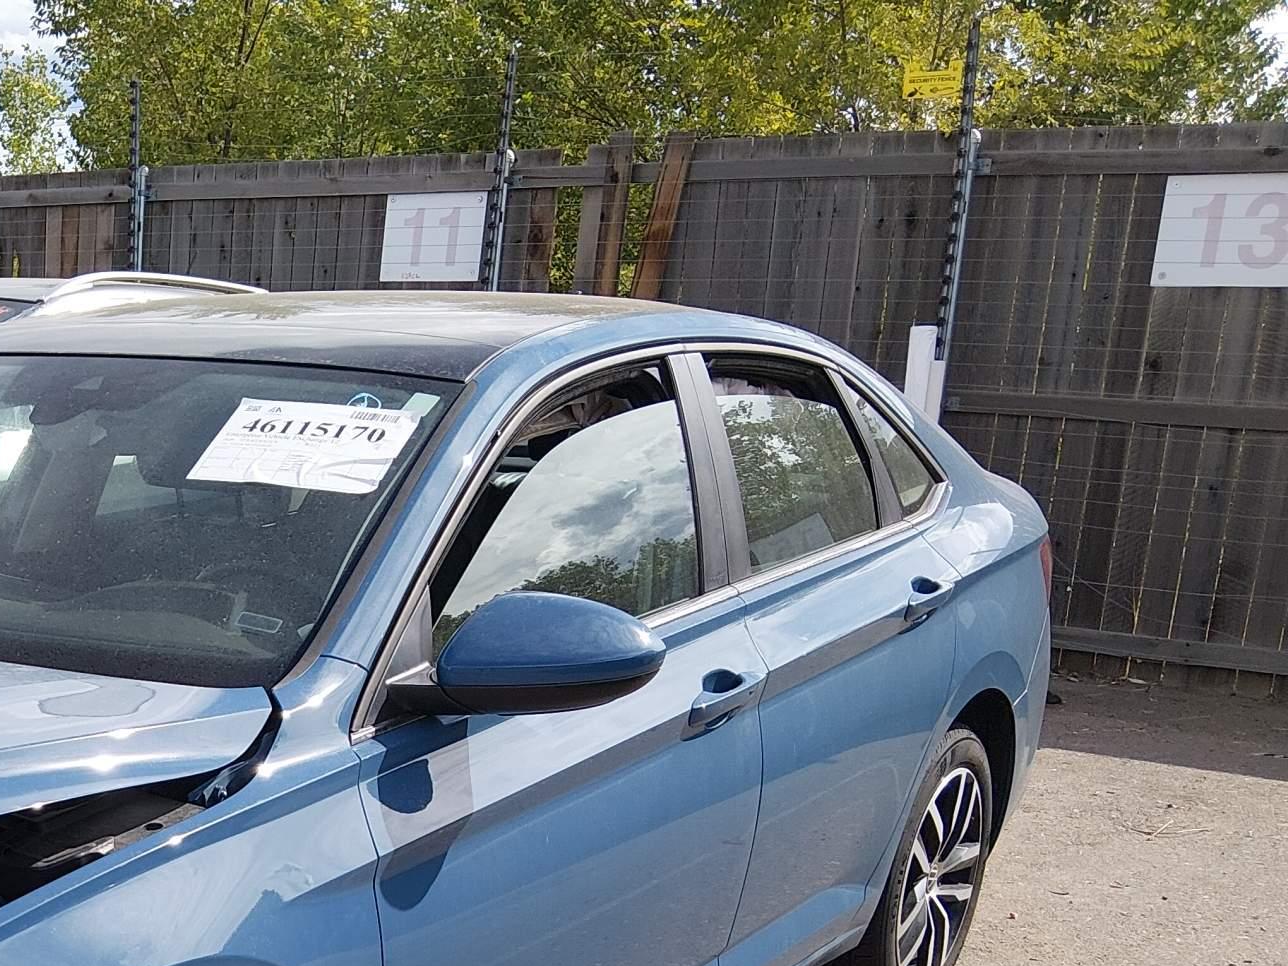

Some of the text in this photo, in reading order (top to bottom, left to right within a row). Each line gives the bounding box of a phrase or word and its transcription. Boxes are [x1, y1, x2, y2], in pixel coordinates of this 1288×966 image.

[403, 206, 461, 267] 11
[1192, 191, 1288, 270] 13
[242, 418, 387, 443] 46115170
